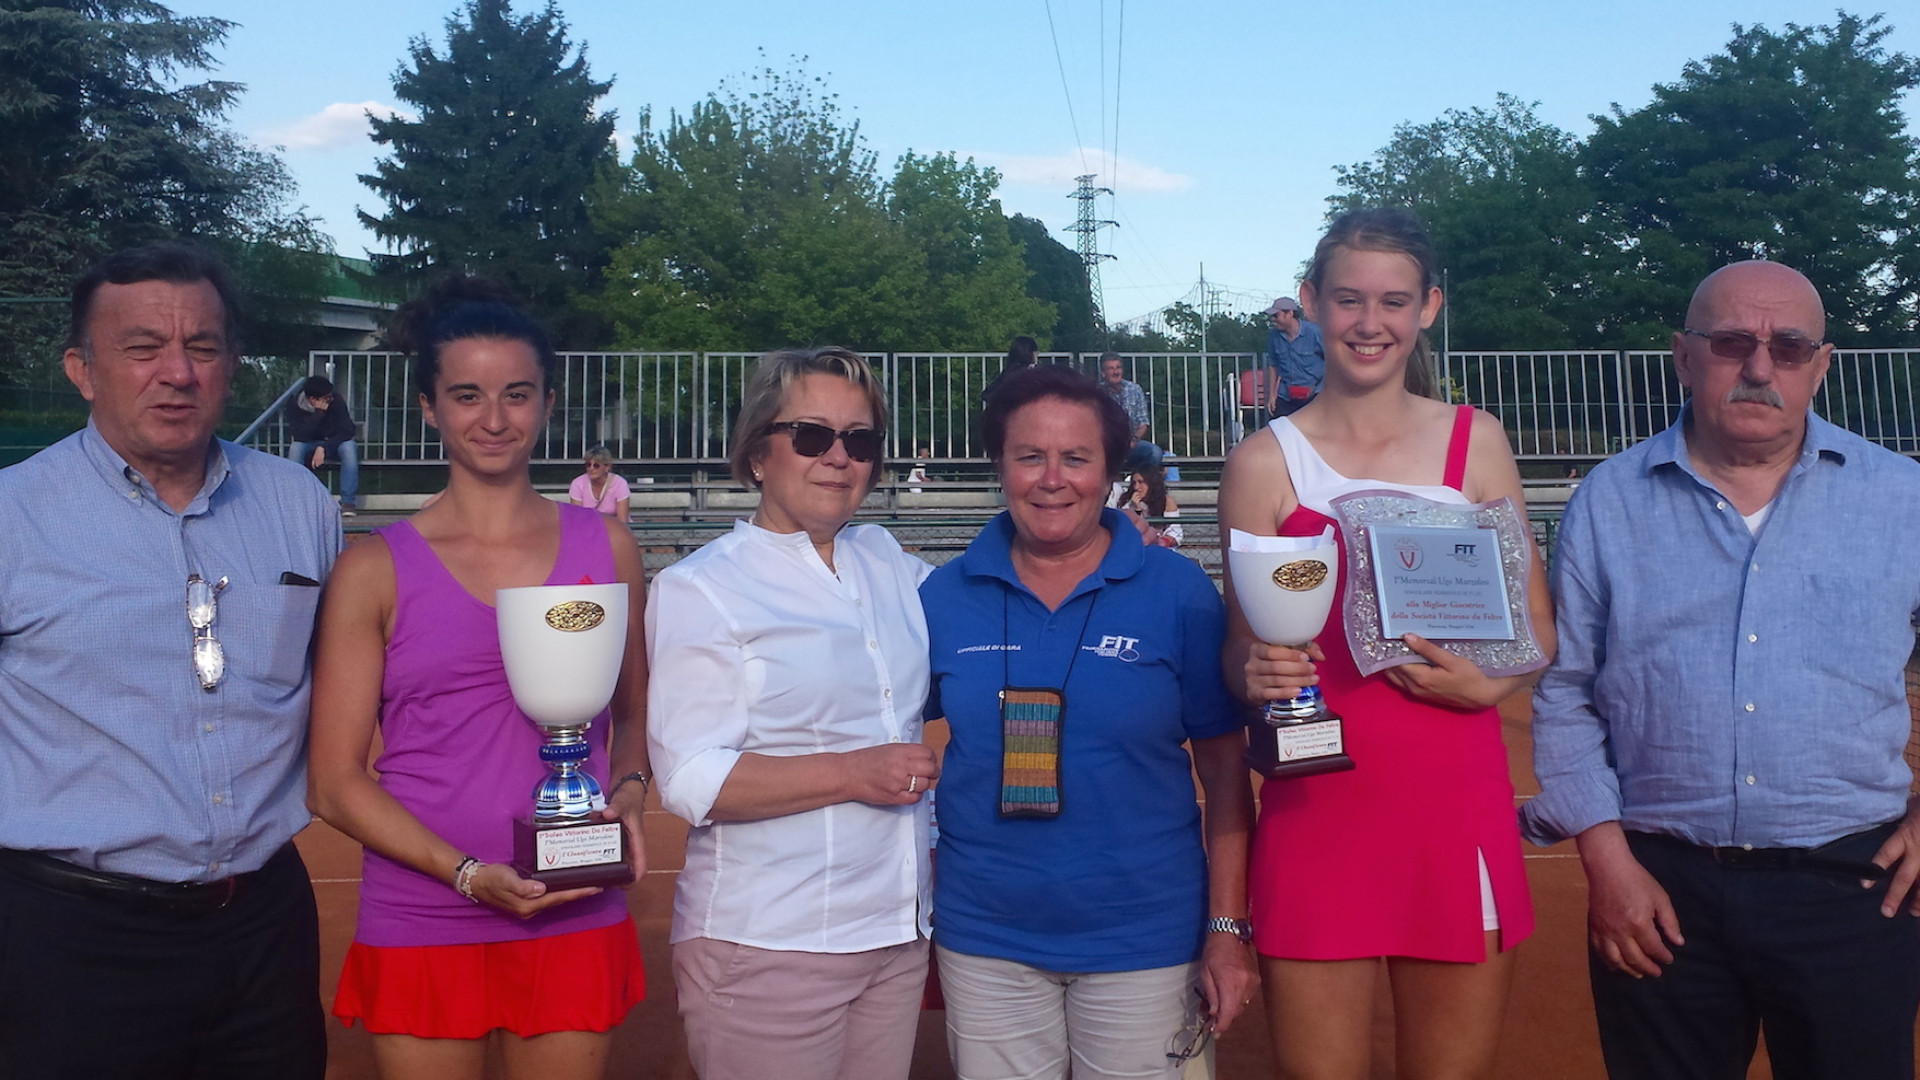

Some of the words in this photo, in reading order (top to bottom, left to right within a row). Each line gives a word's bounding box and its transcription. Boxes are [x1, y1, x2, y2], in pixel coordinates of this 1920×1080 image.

[1455, 544, 1476, 554] FIT
[1100, 635, 1140, 650] FIT
[603, 848, 617, 856] FIT
